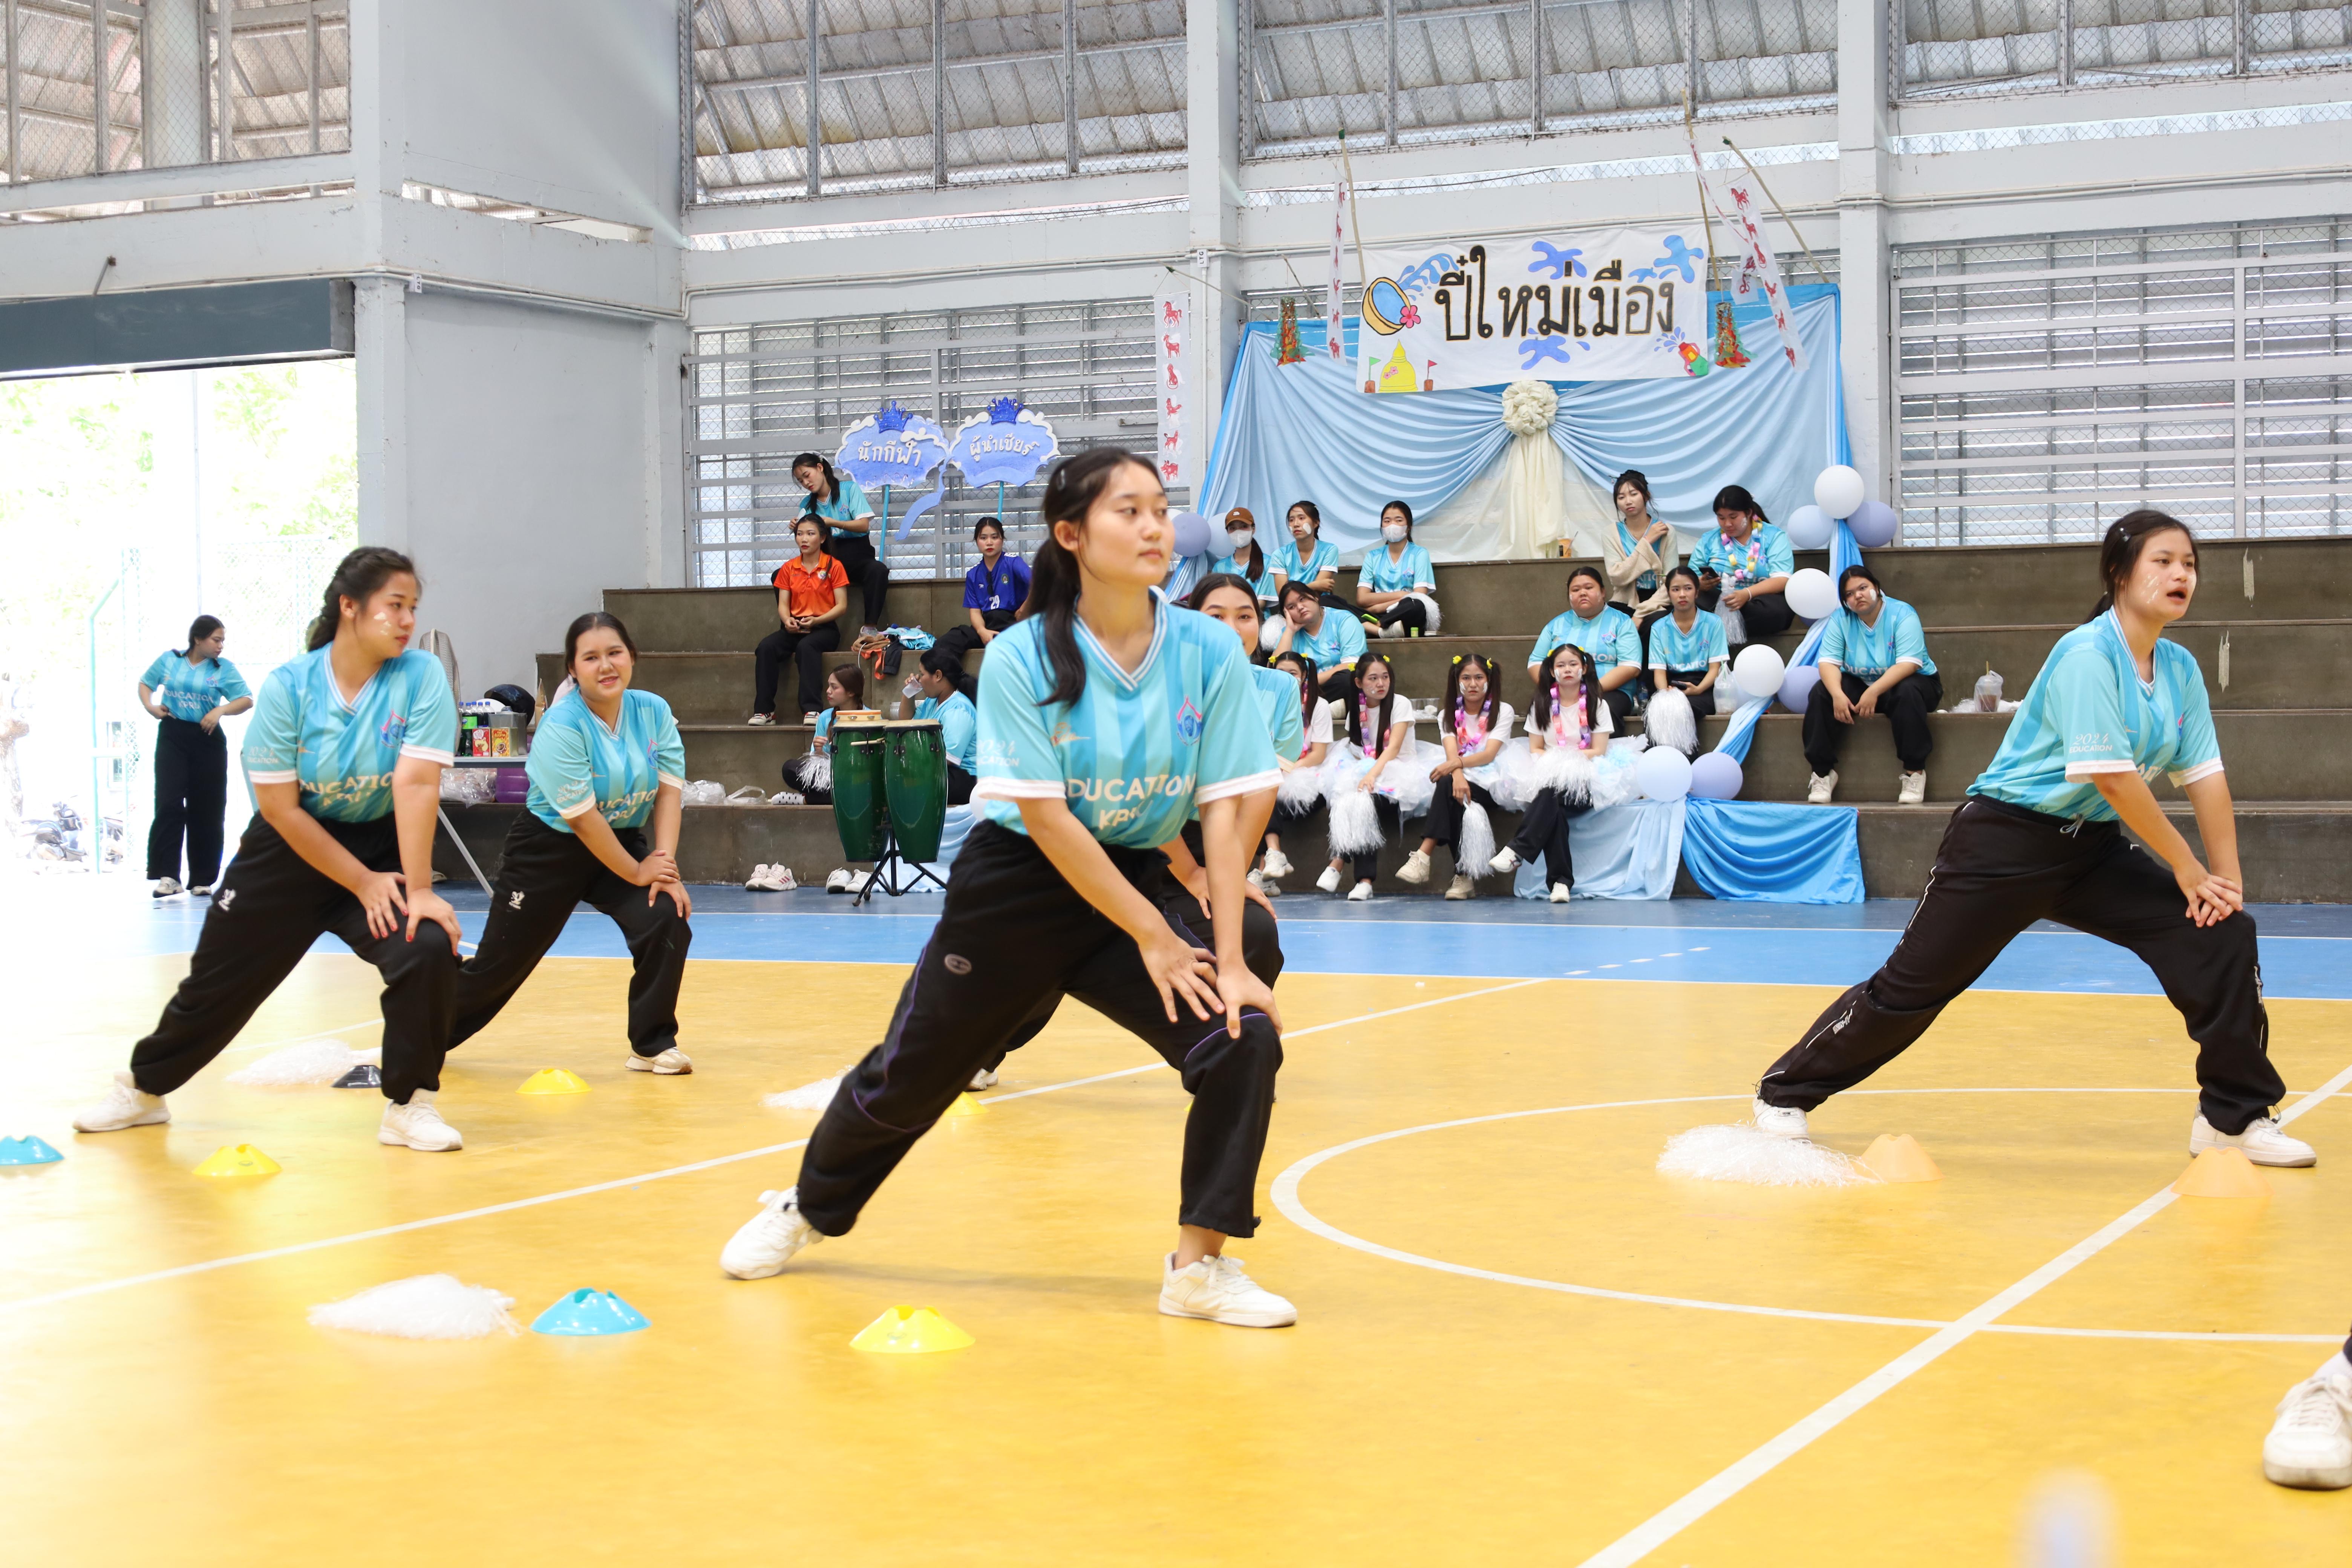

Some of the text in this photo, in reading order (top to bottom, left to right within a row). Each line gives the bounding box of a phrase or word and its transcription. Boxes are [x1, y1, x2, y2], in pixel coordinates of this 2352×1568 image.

[1434, 244, 1674, 341] ปี๋ใหม่เมือง
[858, 439, 922, 467] นักกีฬา
[969, 432, 1040, 462] ผู้นำเชียร์
[989, 595, 1000, 610] 29
[2069, 744, 2112, 754] EDUCATION
[2073, 733, 2109, 745] 2024
